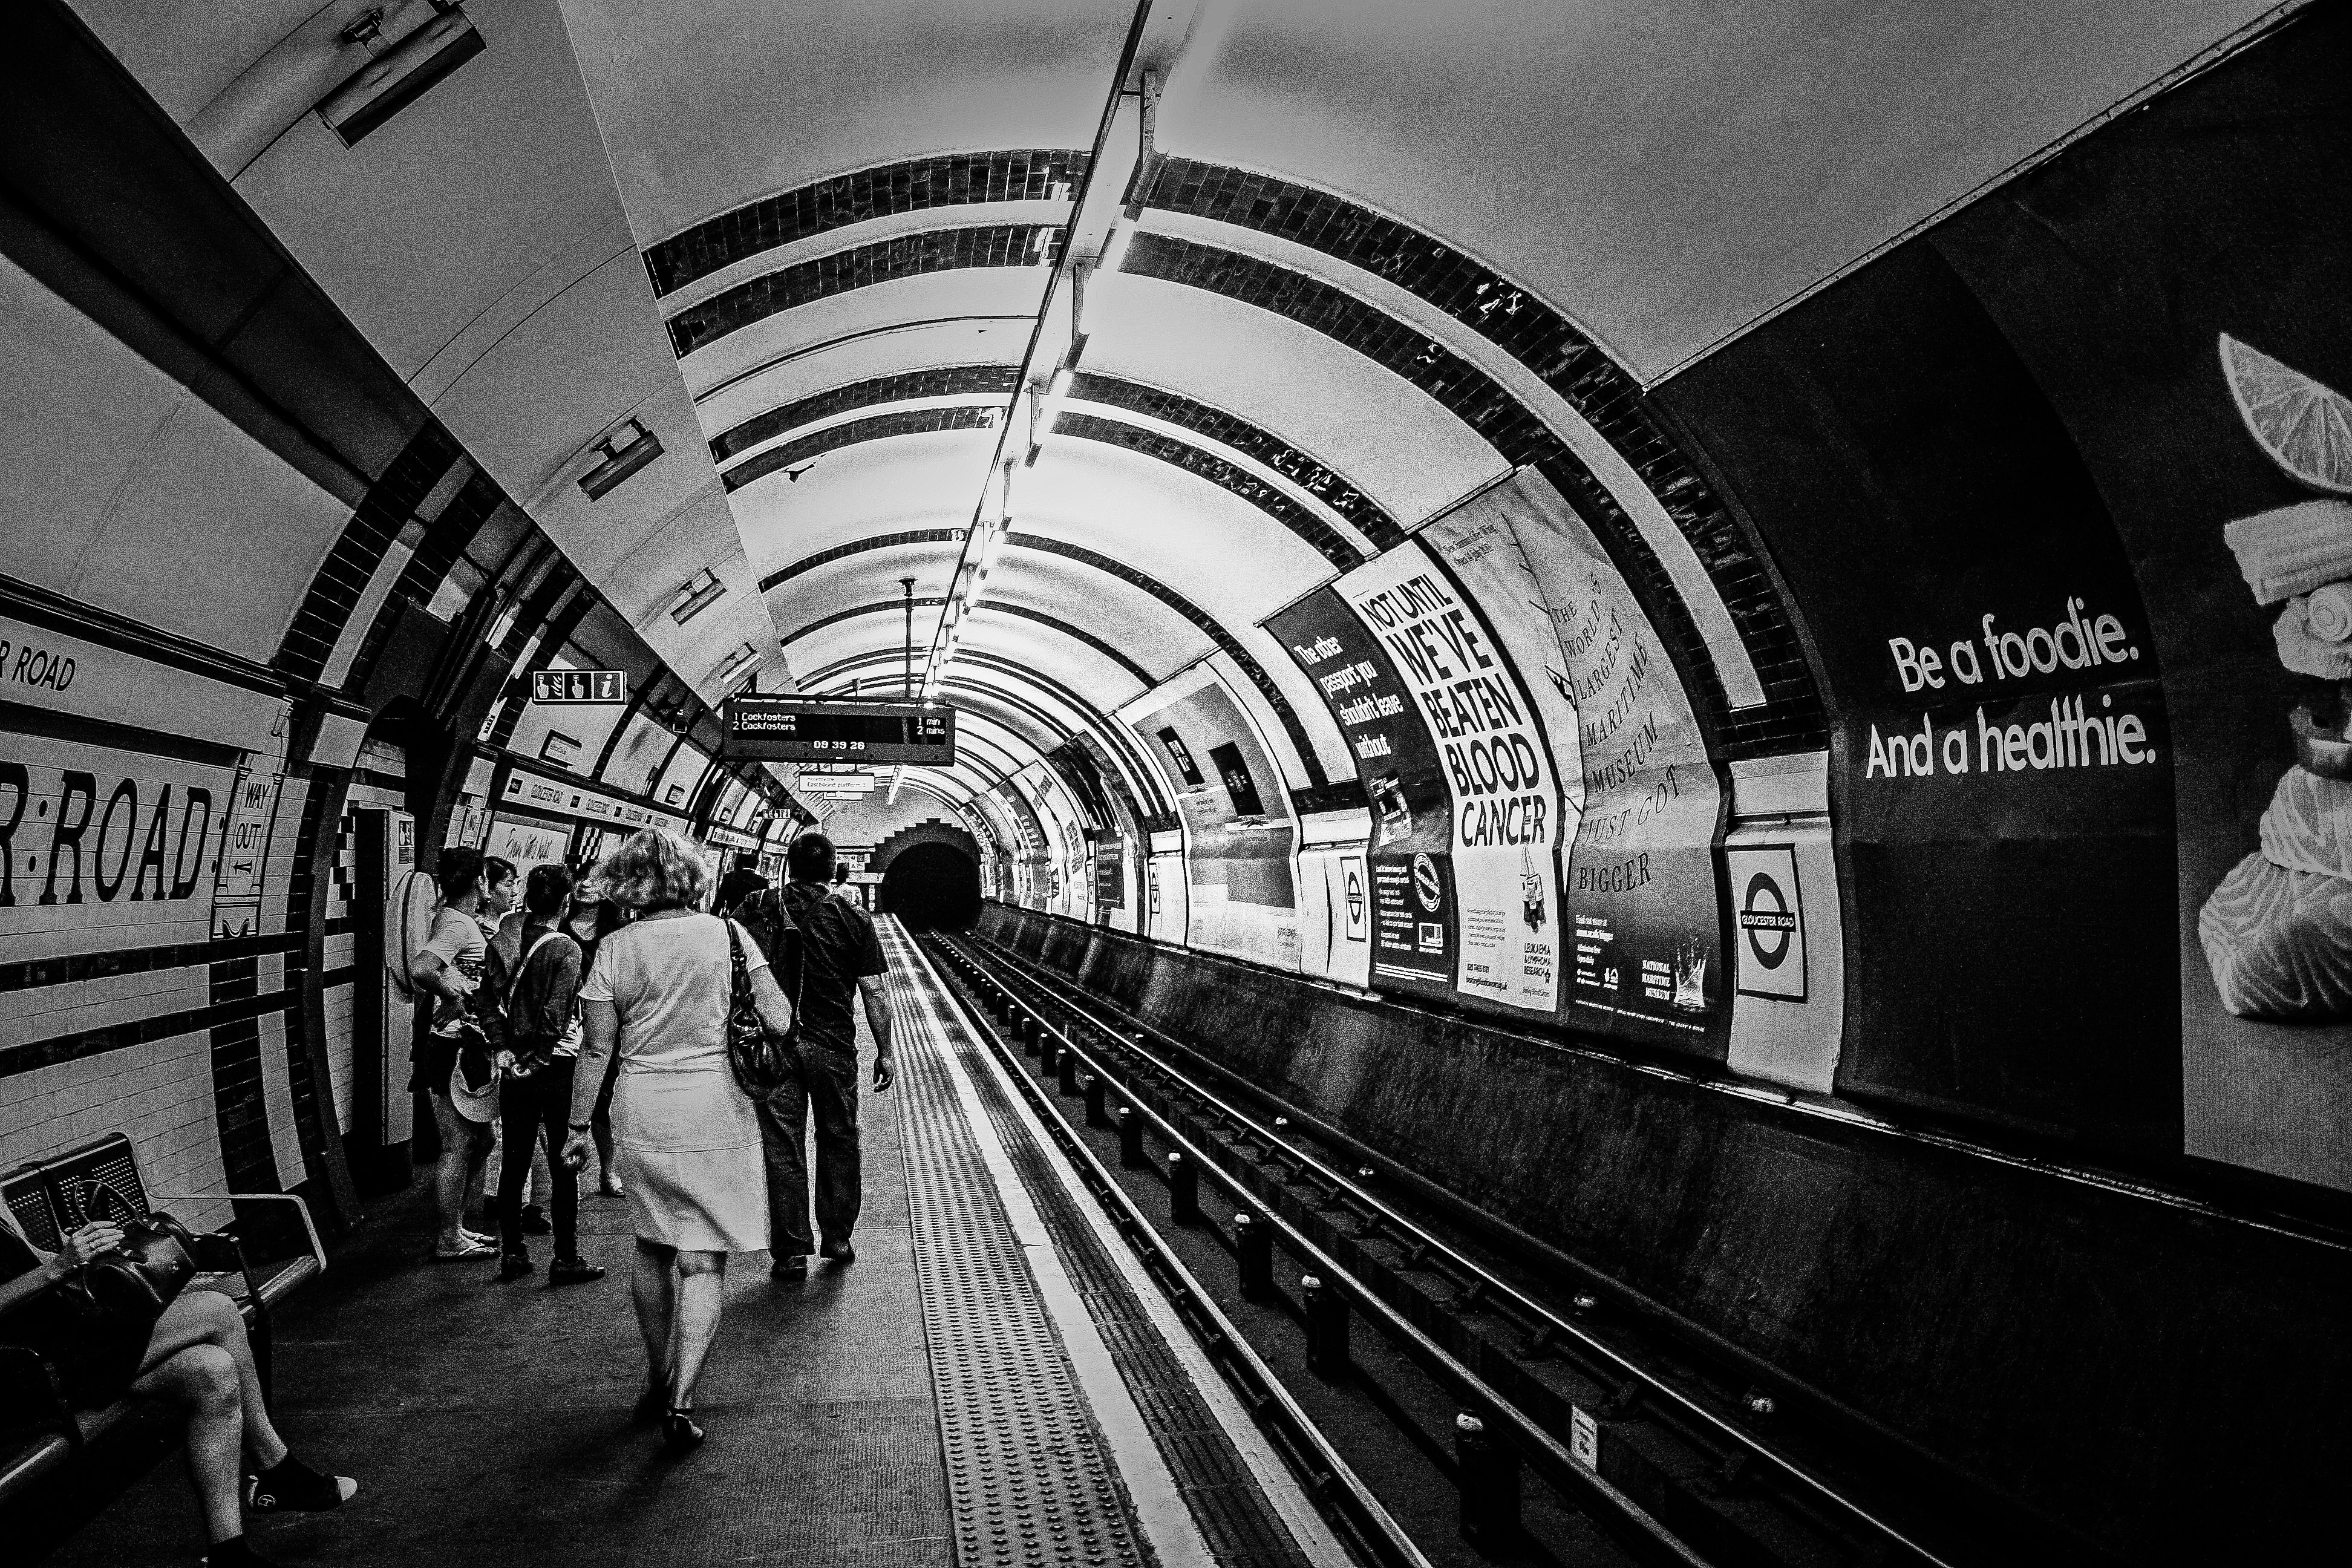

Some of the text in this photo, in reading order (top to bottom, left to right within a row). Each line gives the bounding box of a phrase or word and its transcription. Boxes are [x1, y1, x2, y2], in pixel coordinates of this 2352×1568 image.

[1359, 573, 1454, 631] NOT UNTIL
[12, 645, 76, 691] ROAD
[1293, 636, 1343, 665] The other
[1385, 609, 1494, 685] WE'VE
[1577, 607, 1622, 701] LARGEST
[1889, 596, 2139, 692] Be a foodie.
[1319, 660, 1378, 699] passport you
[1420, 673, 1523, 739] BEATEN
[1585, 632, 1647, 746] MARITIME
[742, 713, 796, 722] Cockfosters
[742, 722, 796, 731] Cockfosters
[917, 727, 923, 735] 2
[1339, 693, 1403, 726] shouldn't leave
[1865, 693, 2156, 779] And a healthie.
[850, 742, 865, 750] 26
[1355, 733, 1391, 759] without
[1445, 733, 1539, 797] BLOOD
[1592, 710, 1659, 793] MUSEUM
[246, 782, 270, 809] WAY
[1462, 794, 1546, 848] CANCER
[1581, 763, 1680, 847] JUST GOT
[39, 769, 212, 903] ROAD
[236, 823, 262, 849] OUT
[1579, 852, 1650, 893] BIGGER
